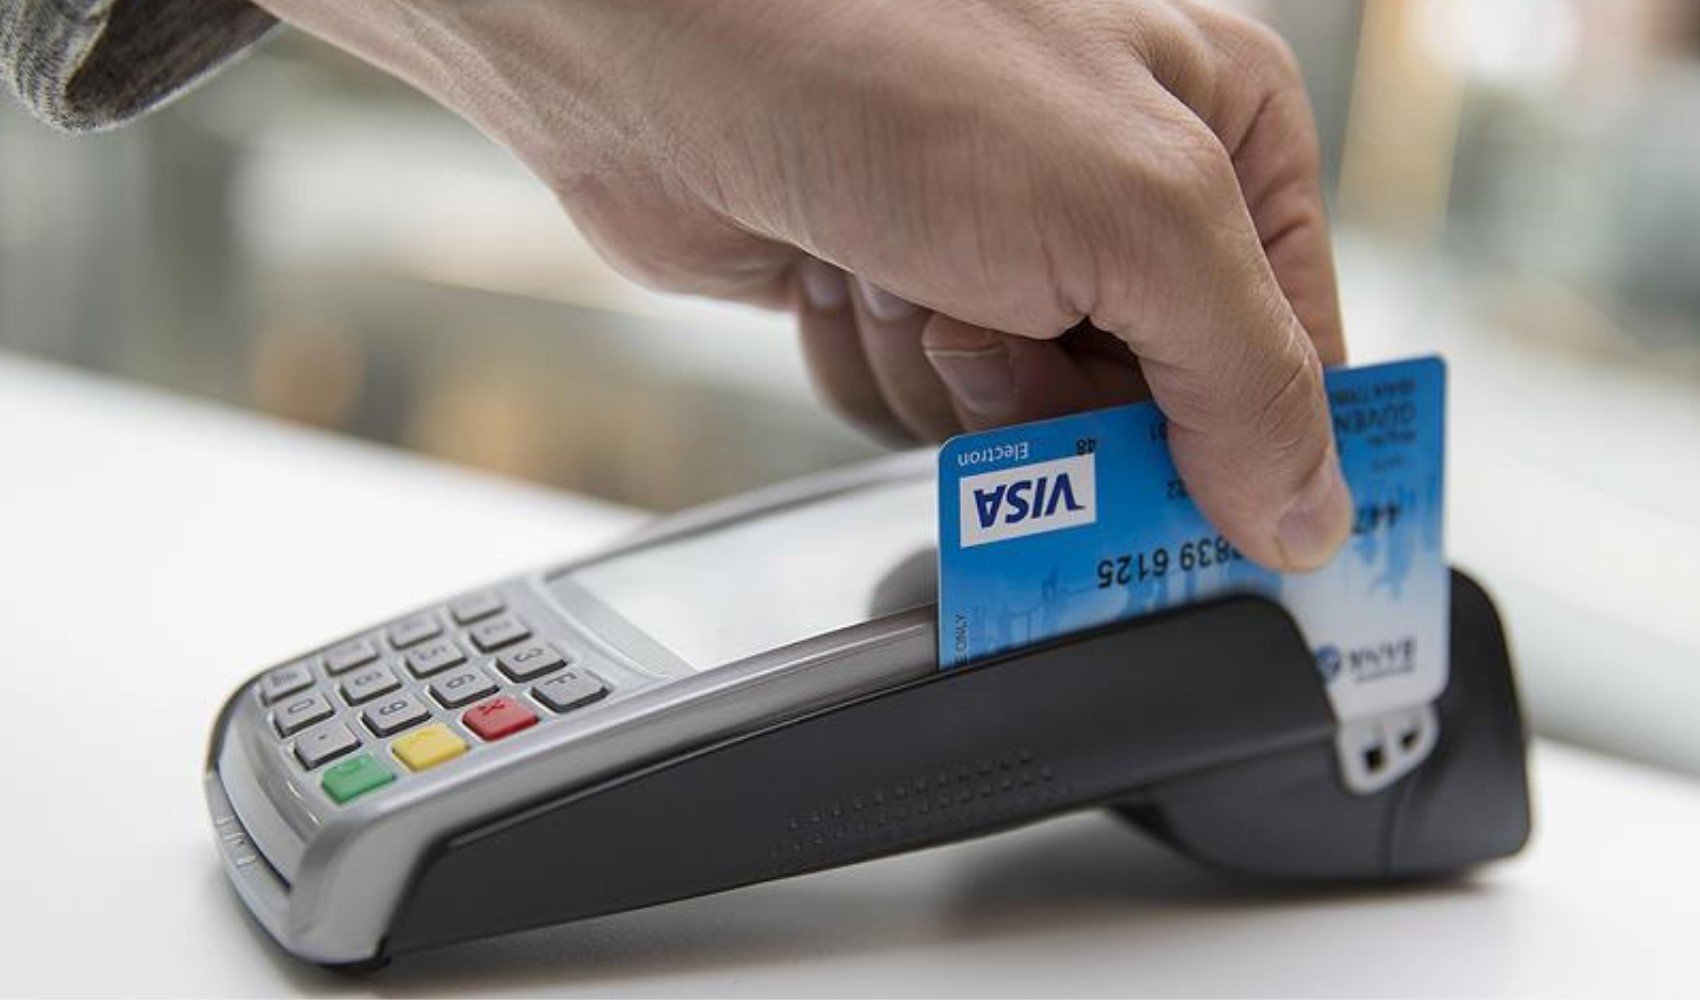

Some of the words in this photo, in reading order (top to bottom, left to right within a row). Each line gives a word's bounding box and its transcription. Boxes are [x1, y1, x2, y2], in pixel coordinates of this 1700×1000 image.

[957, 440, 1030, 467] Electron
[1076, 437, 1097, 455] 48
[973, 472, 1086, 530] VISA
[1096, 547, 1169, 589] 6125
